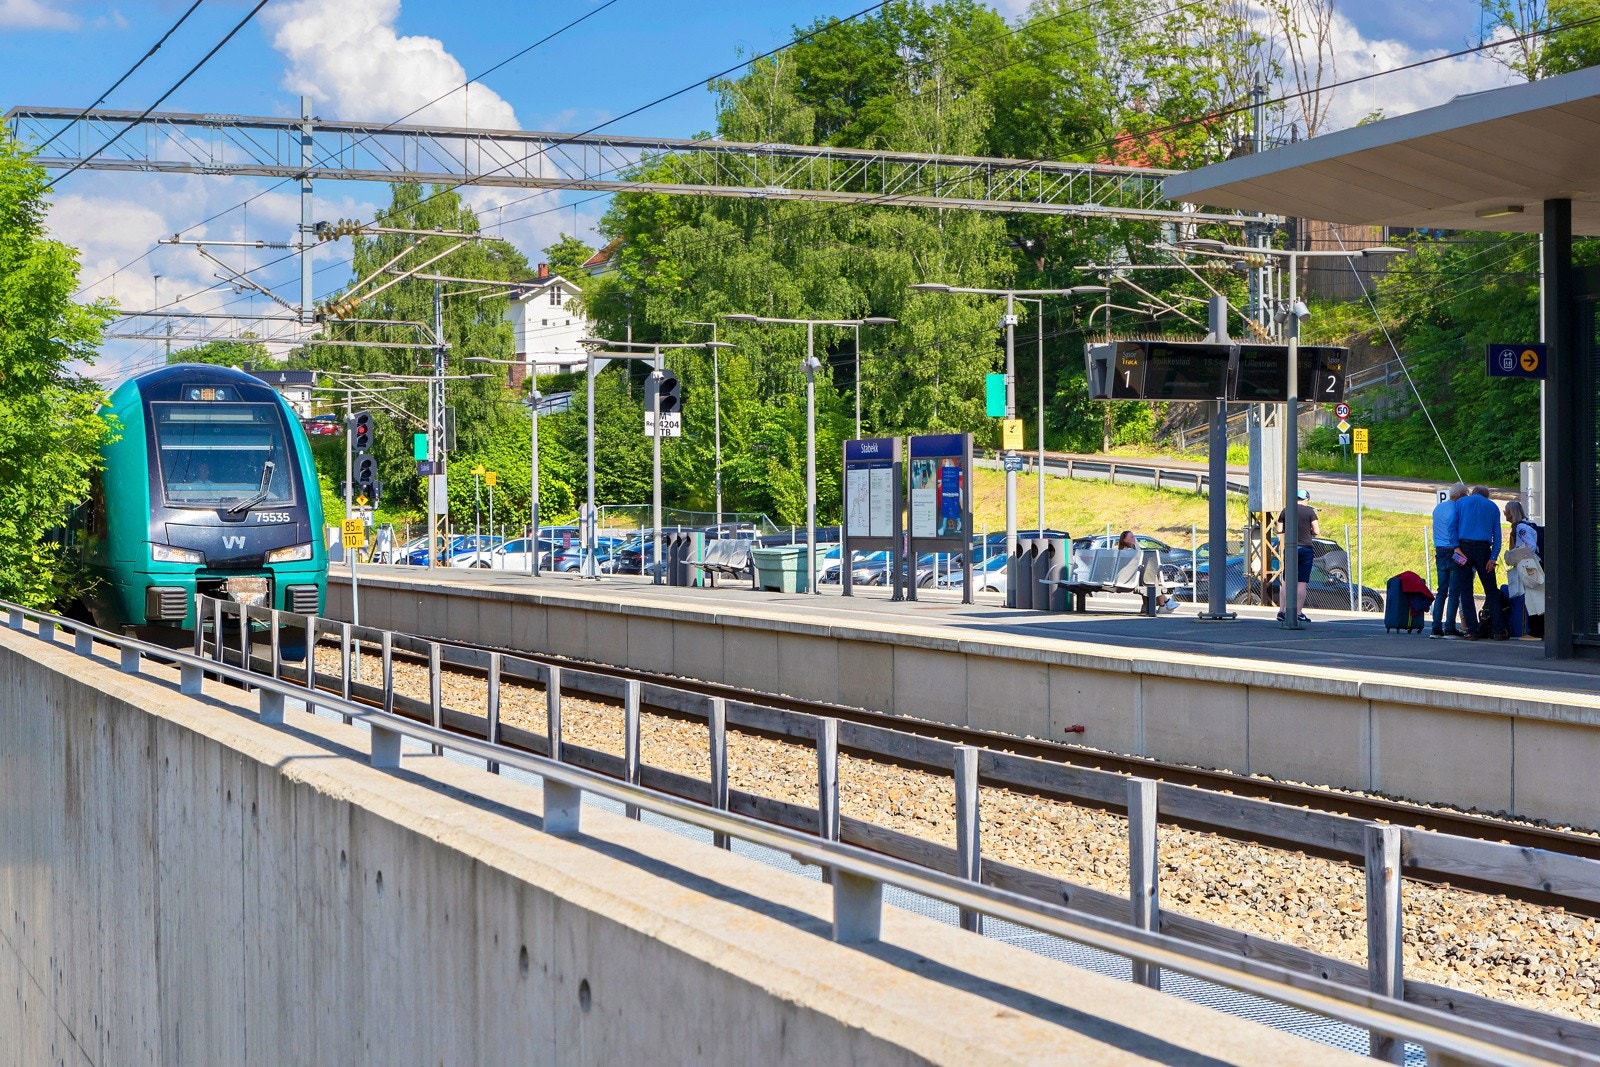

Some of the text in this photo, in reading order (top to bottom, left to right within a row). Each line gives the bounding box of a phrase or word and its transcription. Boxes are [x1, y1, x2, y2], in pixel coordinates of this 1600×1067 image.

[1124, 370, 1131, 389] 1
[1325, 375, 1336, 393] 2
[1337, 406, 1348, 415] 50
[1355, 430, 1362, 439] 85
[860, 442, 879, 453] Stabekk
[1355, 442, 1363, 451] 110
[1440, 492, 1447, 503] P
[254, 512, 290, 523] 75535
[345, 521, 355, 531] 85
[344, 535, 357, 545] 110
